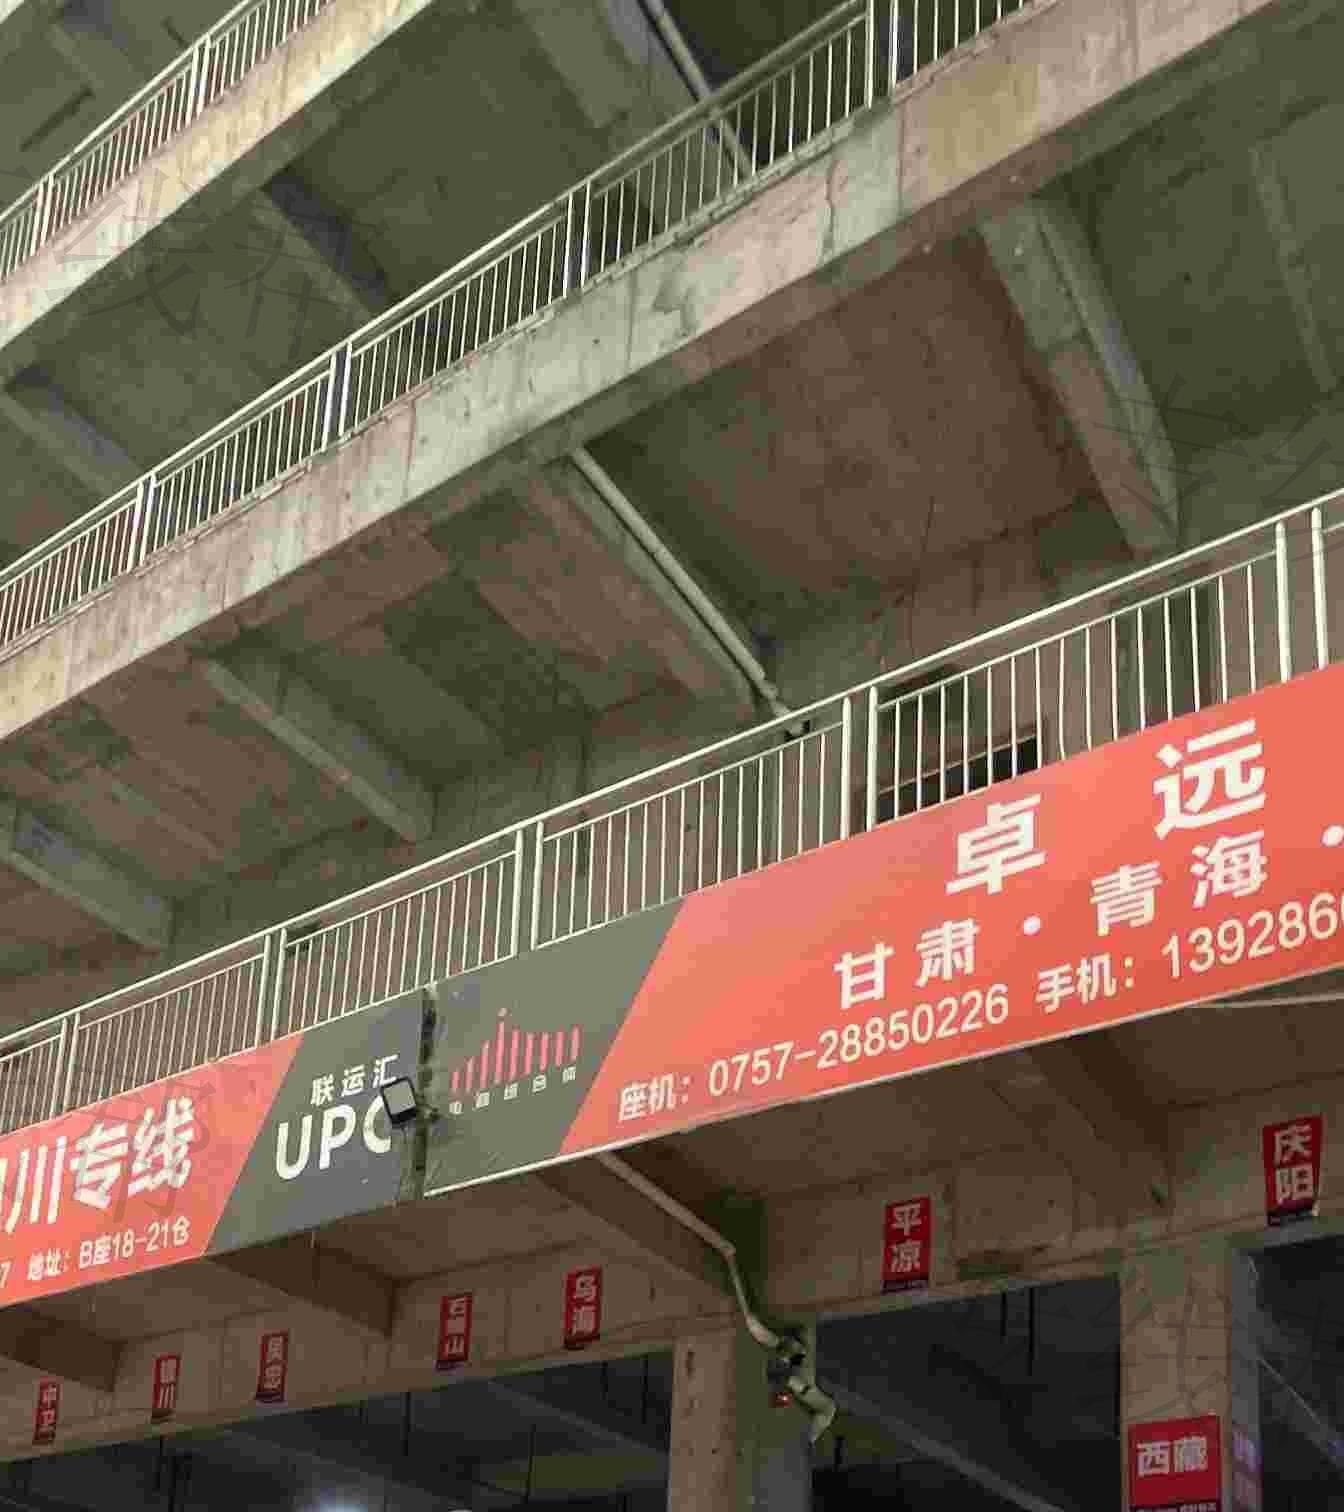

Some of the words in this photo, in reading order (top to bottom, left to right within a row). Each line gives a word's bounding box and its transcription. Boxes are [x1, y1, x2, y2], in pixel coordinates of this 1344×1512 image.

[1270, 1123, 1316, 1204] 庆阳
[888, 1203, 925, 1278] 平凉
[1136, 1435, 1209, 1479] 西藏
